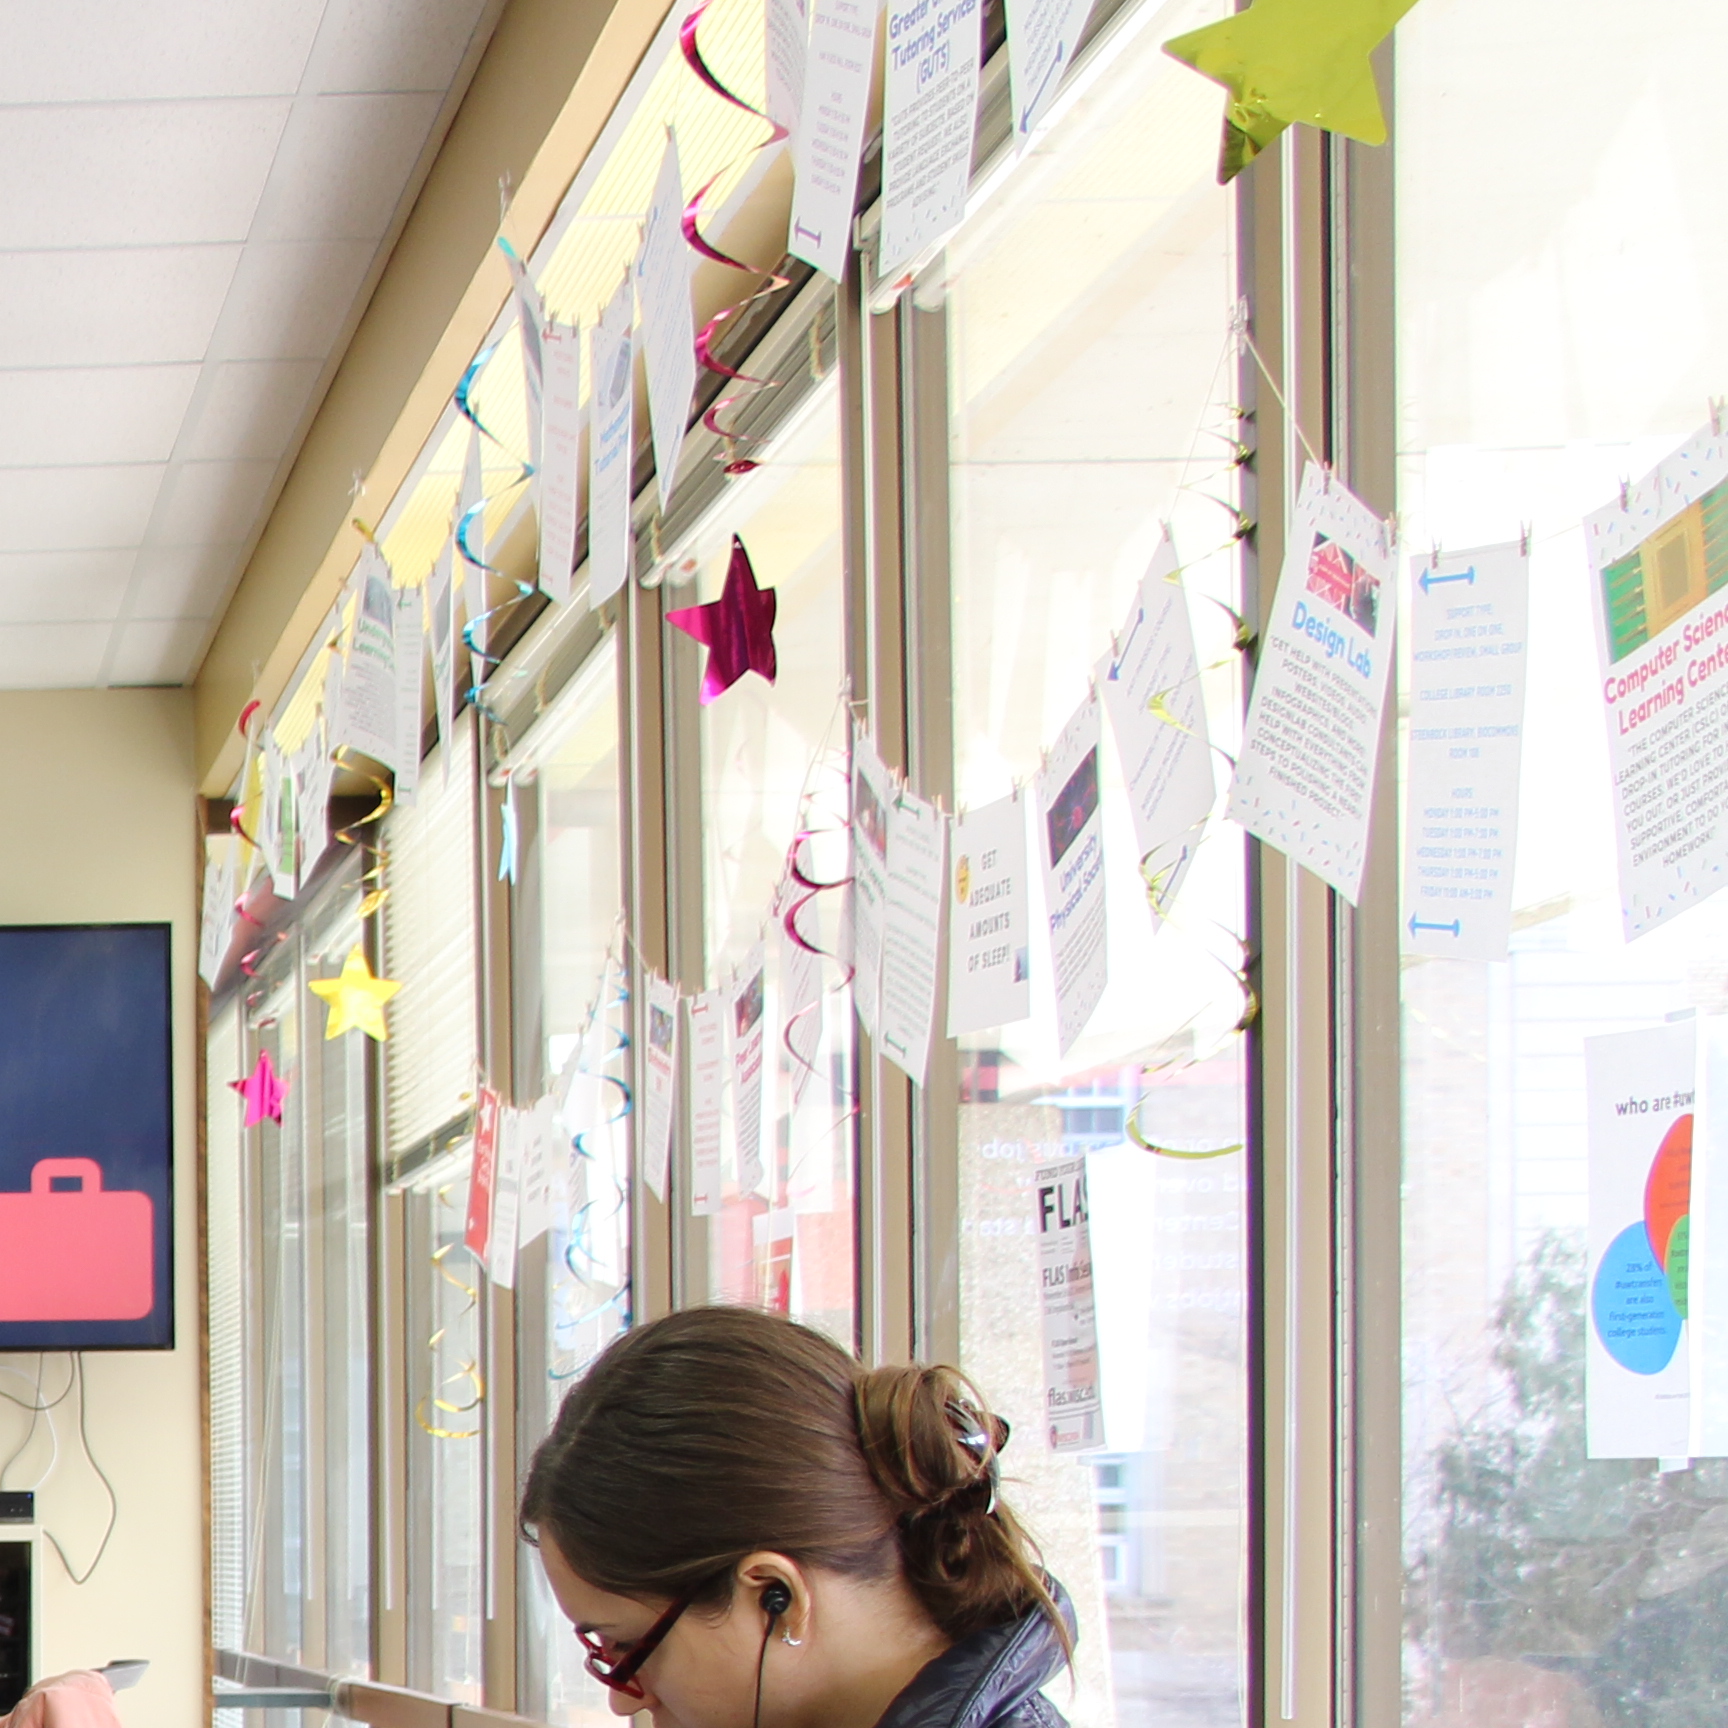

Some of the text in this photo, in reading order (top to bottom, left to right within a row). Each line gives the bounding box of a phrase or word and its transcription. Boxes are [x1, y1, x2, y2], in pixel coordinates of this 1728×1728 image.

[889, 0, 929, 39] Greater
[891, 0, 976, 72] Tutoring Services
[916, 38, 950, 94] (GUTS)
[1291, 600, 1373, 680] Design Lab
[1604, 640, 1680, 704] Computer
[1618, 675, 1685, 736] Learning
[1649, 707, 1695, 745] COMPUTER
[1614, 728, 1691, 786] LEARNING CENTER
[1659, 740, 1701, 775] TUTORING
[1702, 728, 1720, 747] FOR
[1626, 814, 1644, 833] YOU
[1633, 821, 1694, 867] ENVIRONMENT
[981, 849, 997, 871] GET
[968, 878, 1011, 908] ADEQUATE
[968, 911, 1011, 942] AMOUNTS
[968, 952, 979, 973] OF
[1616, 1093, 1671, 1117] who are
